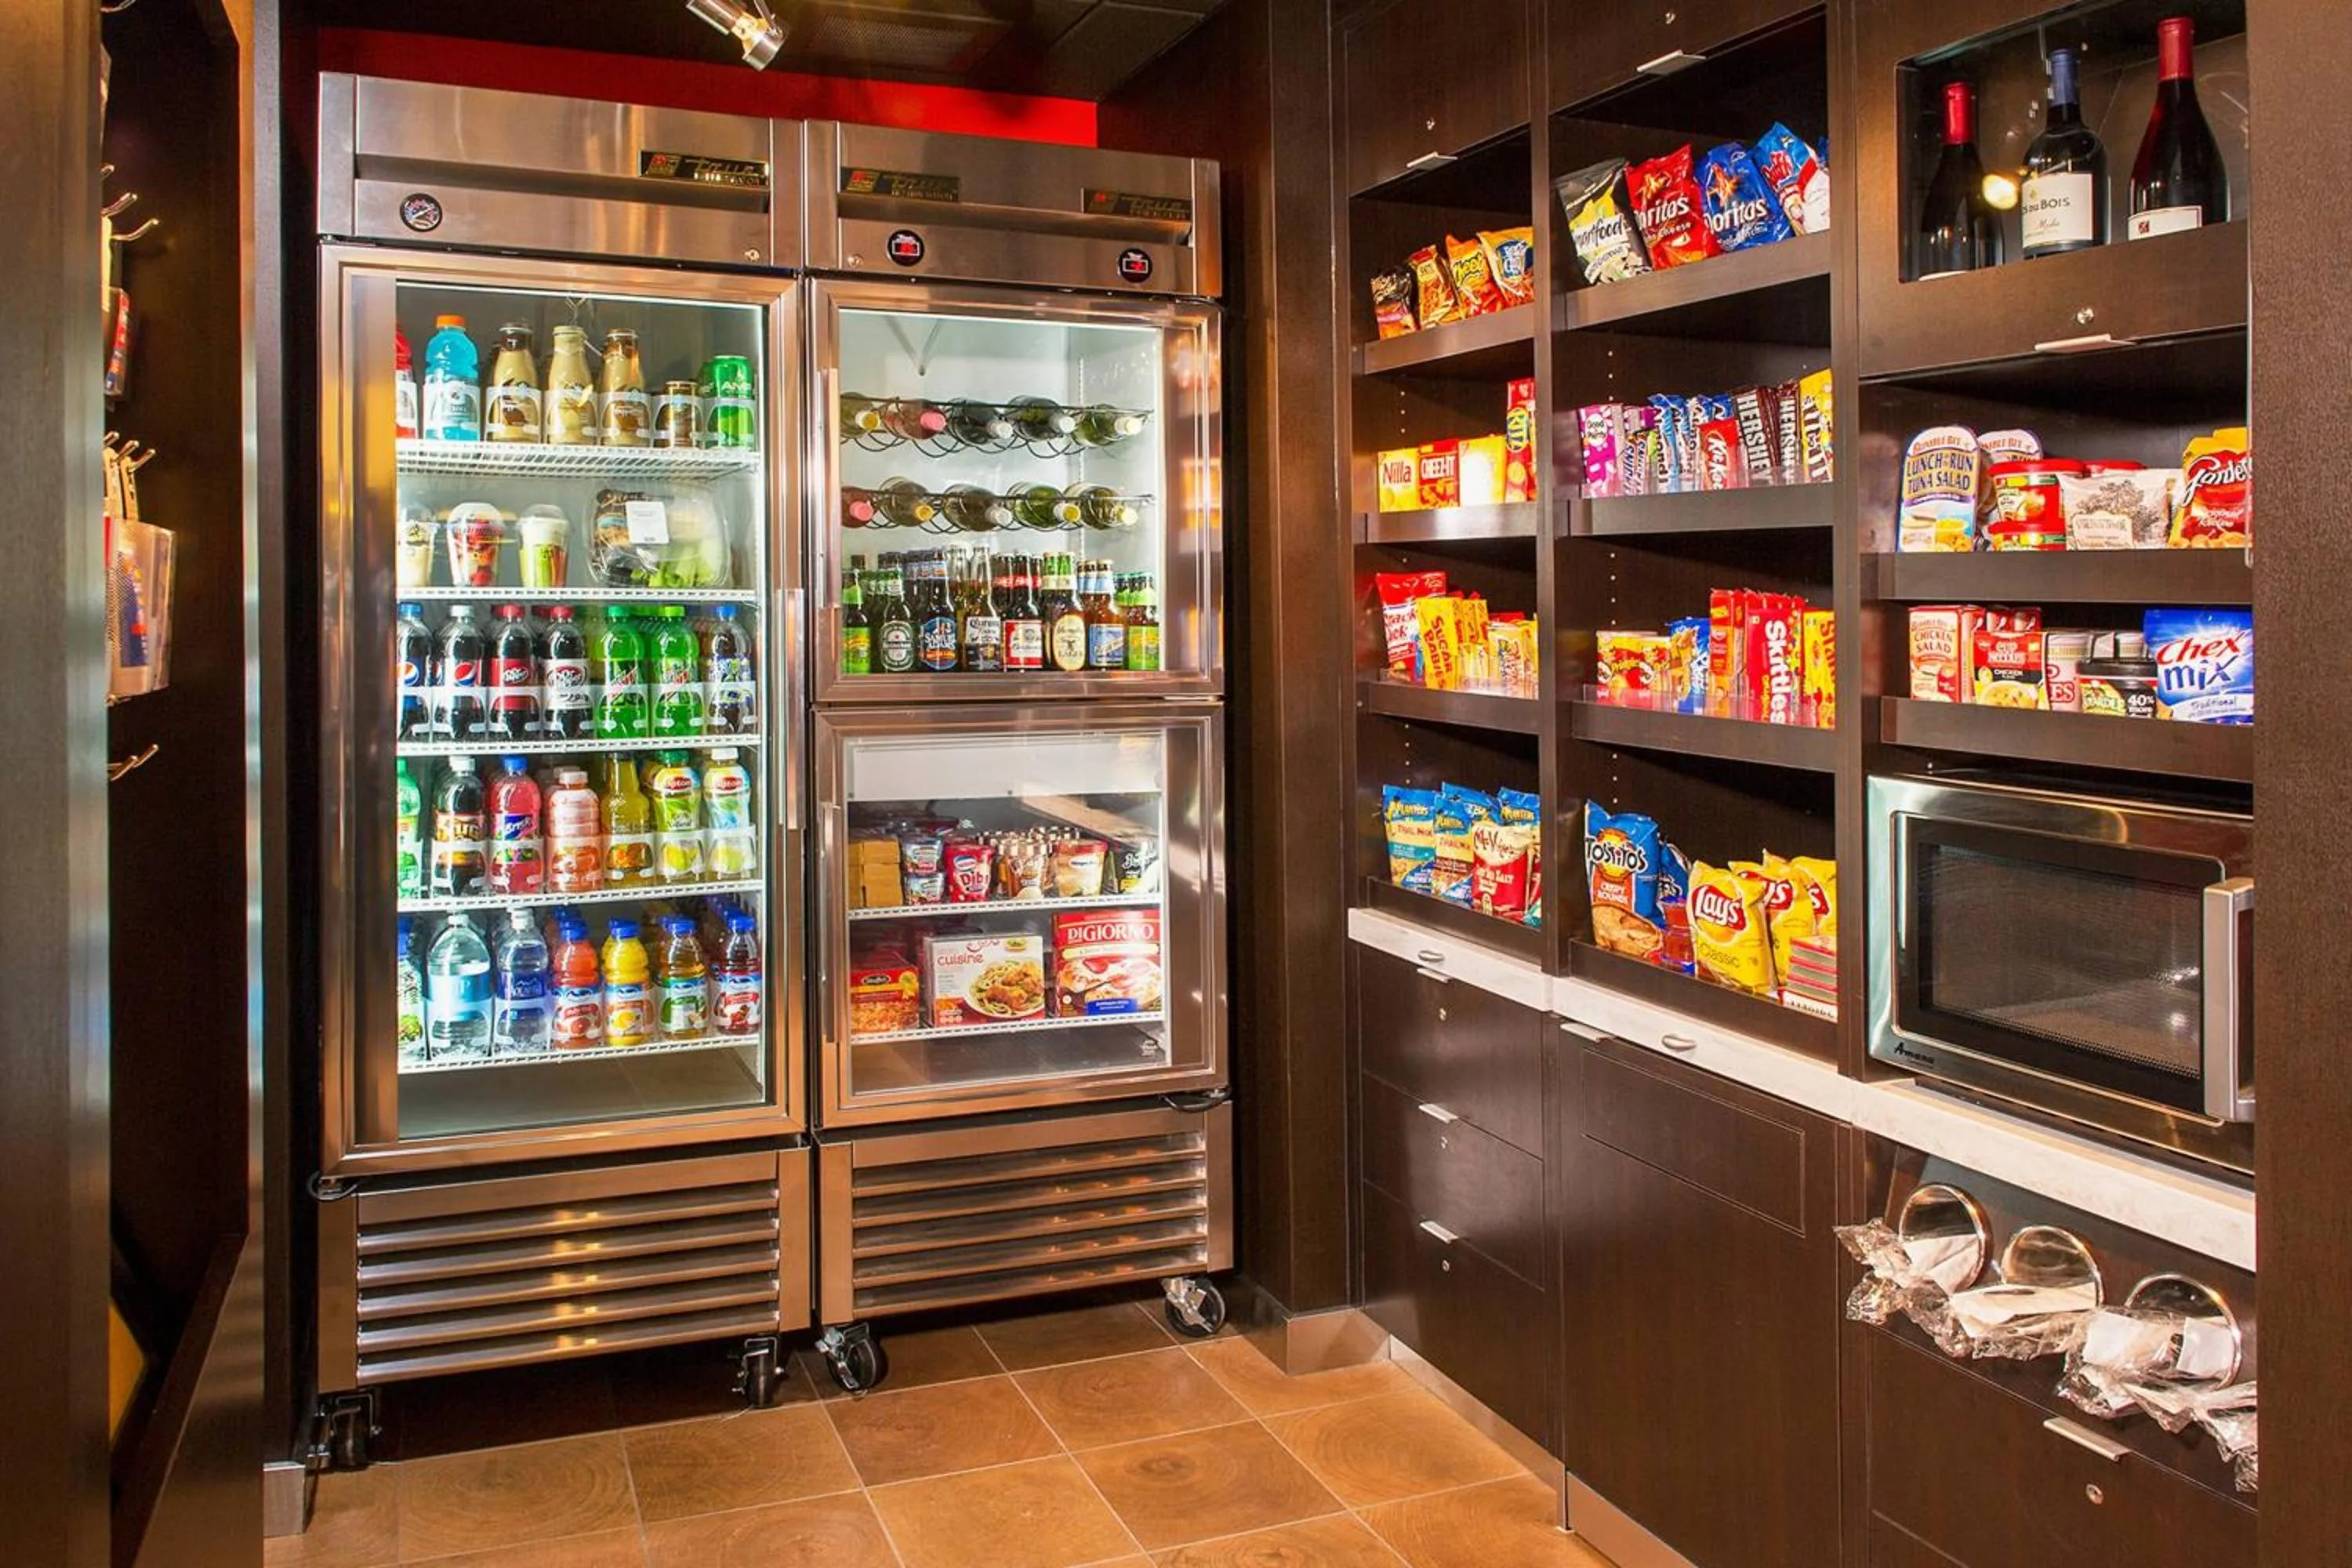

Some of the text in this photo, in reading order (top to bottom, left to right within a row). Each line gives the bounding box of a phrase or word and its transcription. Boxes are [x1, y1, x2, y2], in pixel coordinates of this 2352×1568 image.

[1382, 461, 1411, 484] Nilla
[1907, 452, 1943, 477] LUNCH
[1950, 452, 1973, 471] RUN
[1907, 470, 1970, 493] TUNA SALAD
[1432, 615, 1453, 673] SUGAR
[1914, 630, 1953, 642] CHICKEN
[1915, 642, 1951, 653] SALAD
[2157, 632, 2245, 665] Chex
[1765, 619, 1791, 724] Skittles
[2164, 655, 2239, 690] mix
[2128, 694, 2155, 706] 40%
[1585, 837, 1647, 871] TOSTITOS
[937, 953, 985, 967] cuisine
[1699, 943, 1740, 968] Classic
